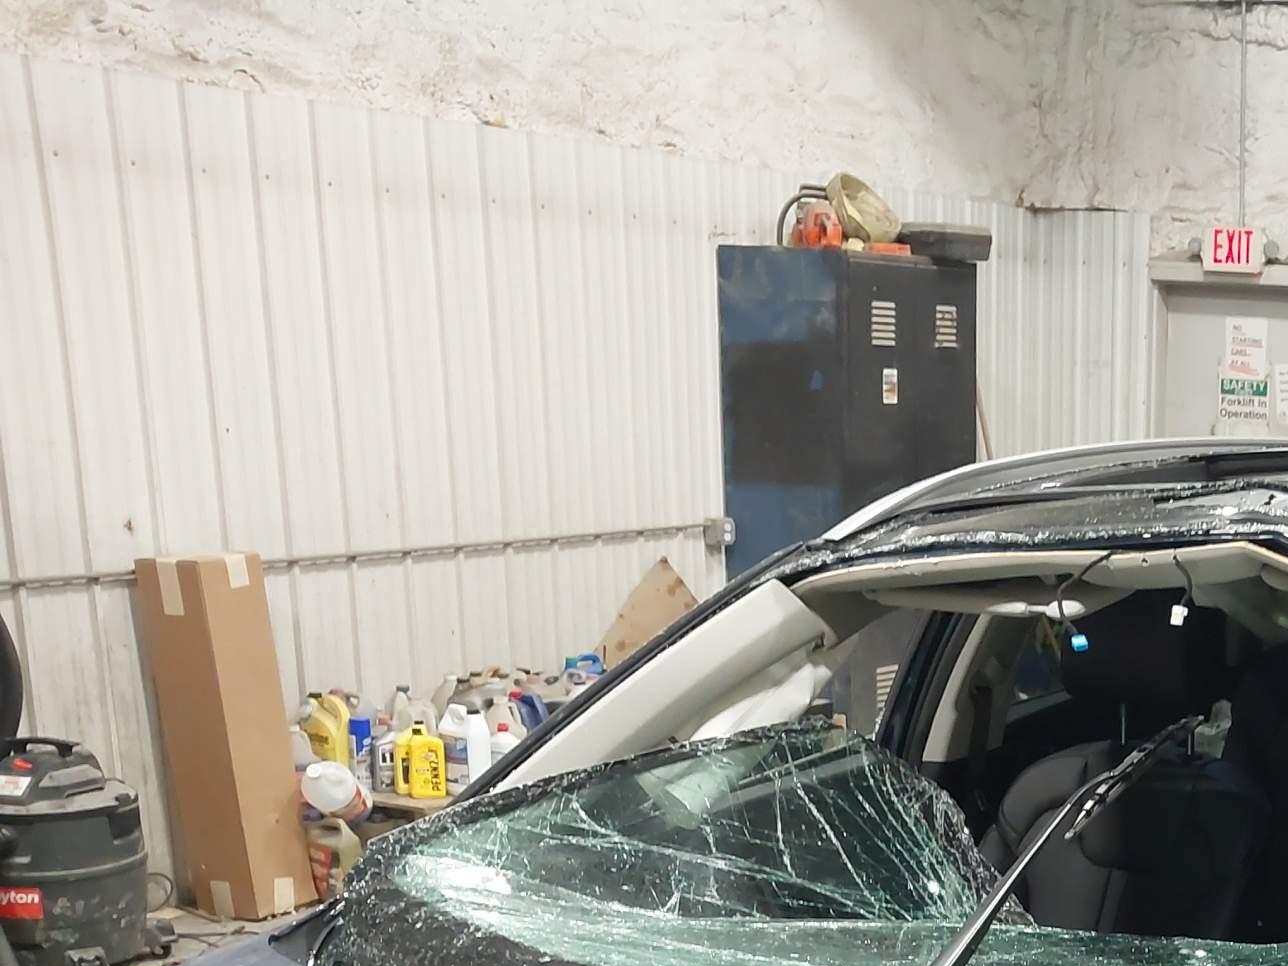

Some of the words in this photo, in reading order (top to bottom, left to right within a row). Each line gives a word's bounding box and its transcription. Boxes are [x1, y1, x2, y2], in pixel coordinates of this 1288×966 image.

[1213, 229, 1253, 264] EXIT
[1223, 379, 1265, 392] SAFETY
[1221, 396, 1255, 408] Forklift
[1220, 408, 1268, 420] Operation
